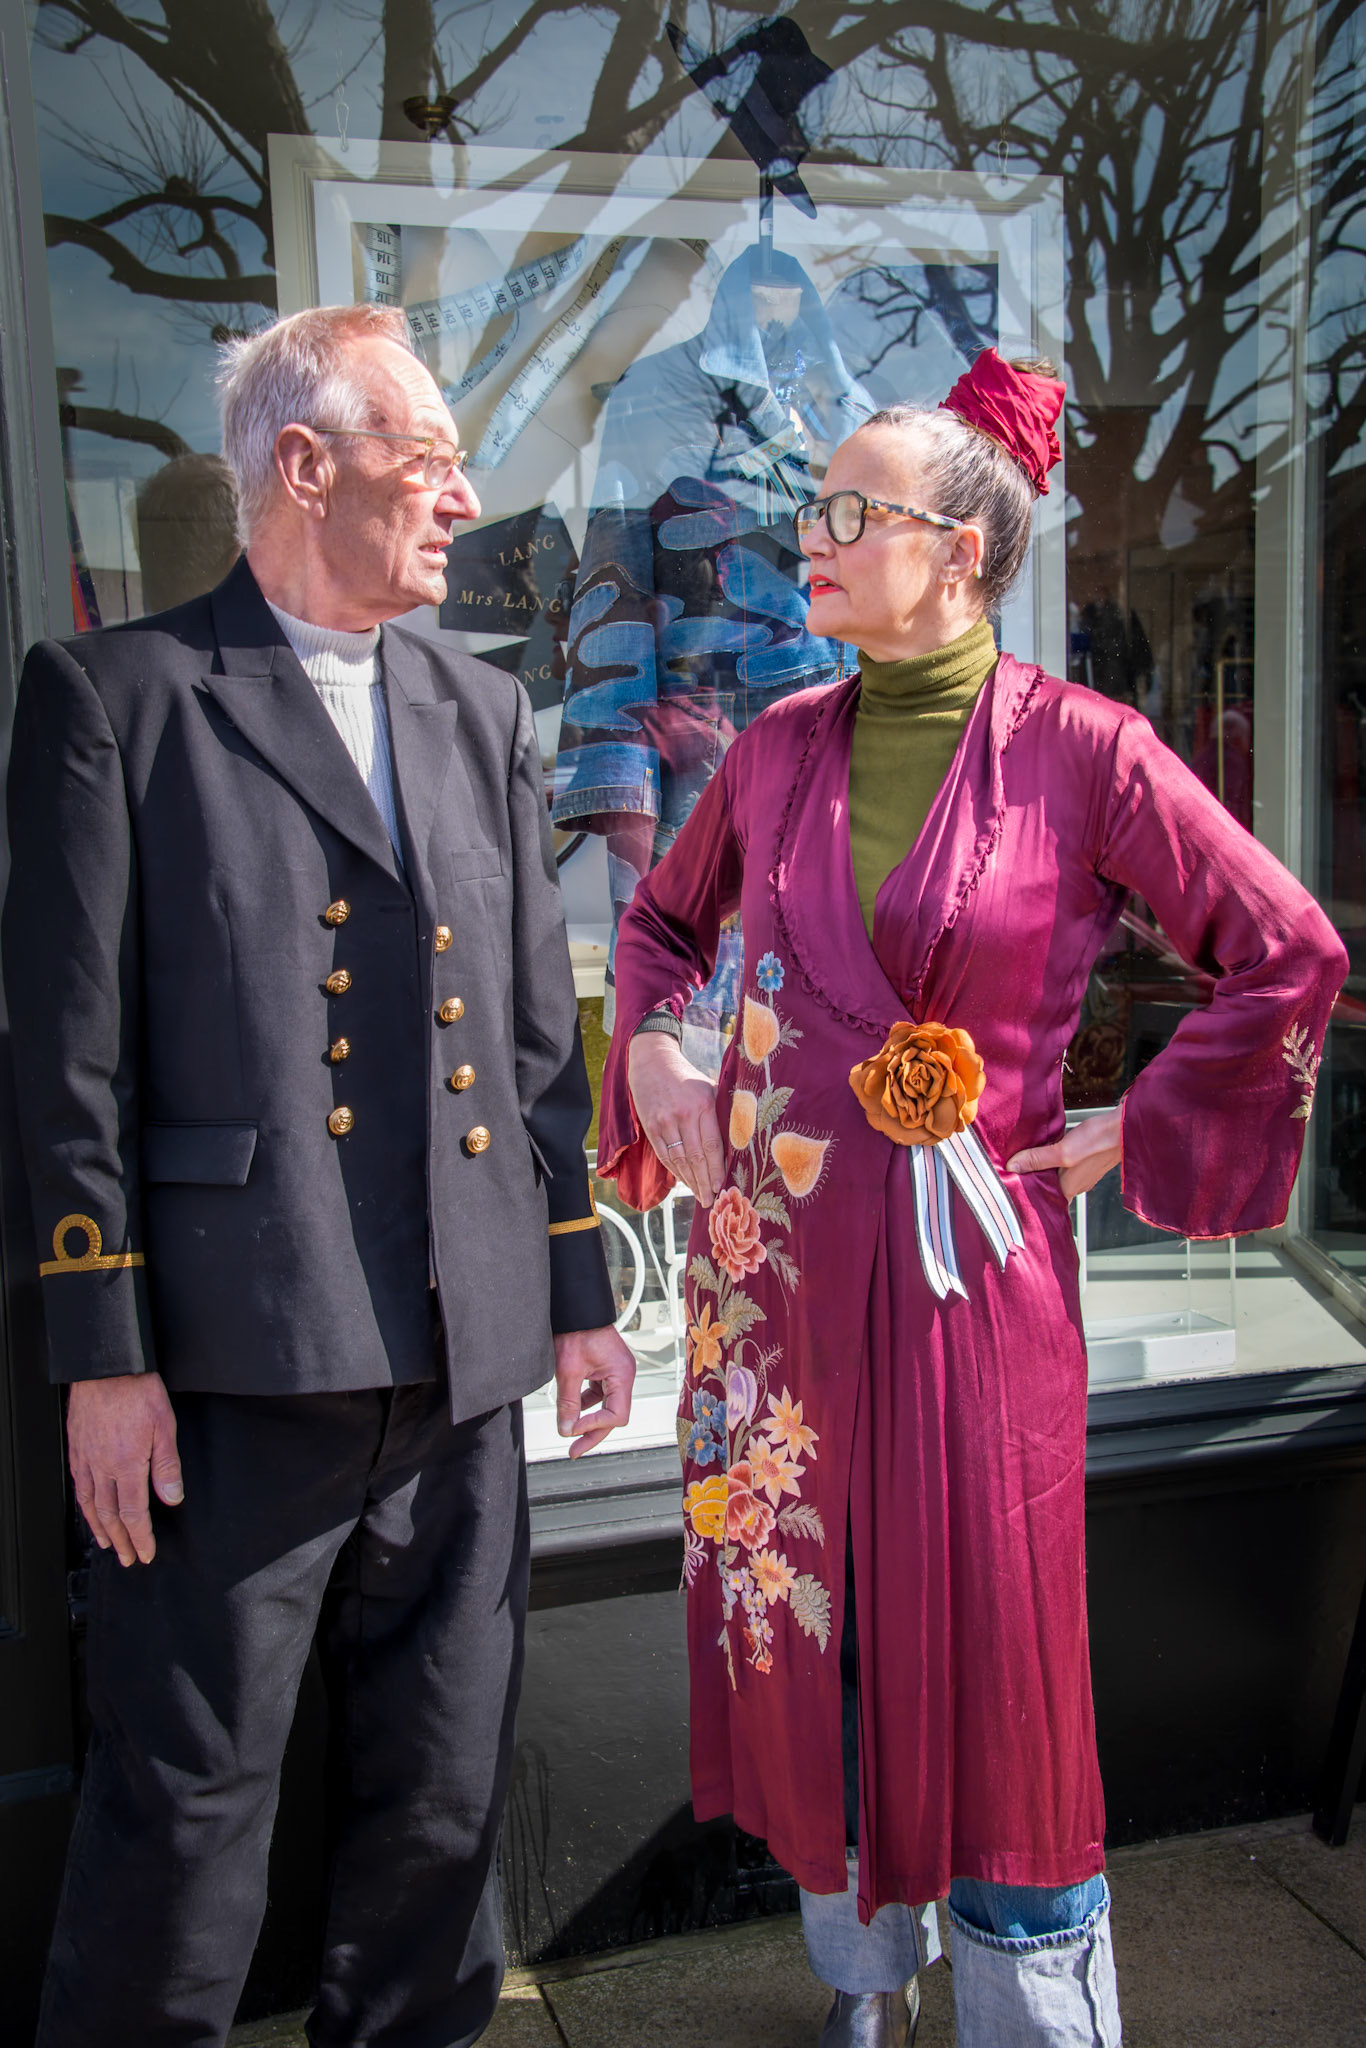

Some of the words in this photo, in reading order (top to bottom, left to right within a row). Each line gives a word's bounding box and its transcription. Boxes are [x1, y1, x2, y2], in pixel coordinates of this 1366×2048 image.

[377, 232, 392, 245] 115
[377, 252, 391, 265] 114
[375, 272, 390, 285] 113
[543, 265, 556, 279] 137
[511, 281, 524, 297] 139
[528, 273, 540, 289] 138
[477, 296, 491, 312] 141
[493, 289, 507, 304] 140
[443, 309, 457, 325] 143
[459, 303, 474, 319] 142
[410, 317, 424, 333] 145
[427, 313, 440, 328] 144
[567, 322, 580, 337] 21
[540, 357, 555, 375] 22
[513, 393, 528, 410] 23
[498, 534, 556, 566] LANG
[456, 589, 493, 606] Mrs
[502, 592, 562, 614] LANG
[523, 664, 552, 686] NG
